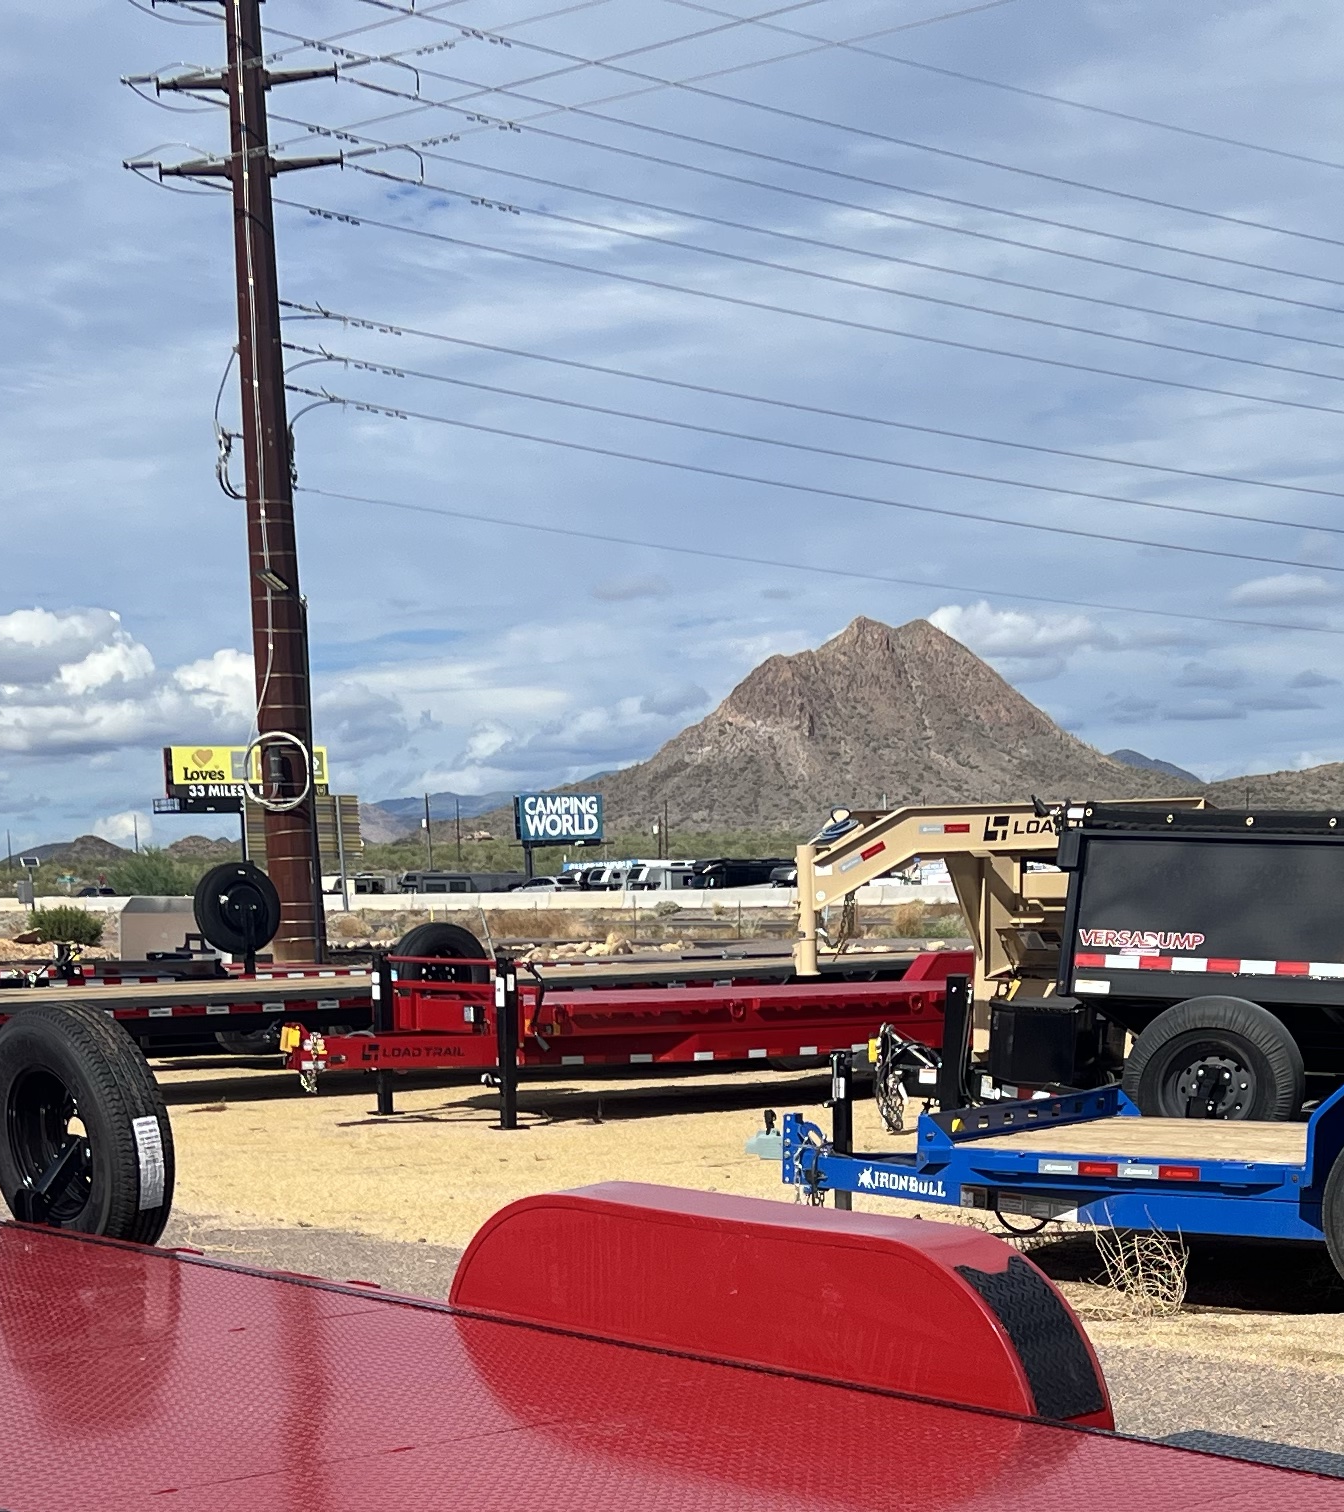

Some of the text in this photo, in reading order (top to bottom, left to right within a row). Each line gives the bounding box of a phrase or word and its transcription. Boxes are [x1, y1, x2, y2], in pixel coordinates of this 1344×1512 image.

[189, 785, 206, 797] 33
[208, 785, 244, 797] MILES
[524, 796, 598, 815] CAMPING
[525, 814, 599, 836] WORLD
[1013, 819, 1054, 835] LOA
[382, 1046, 465, 1058] LOAD TRAIL
[874, 1171, 946, 1197] IRONBULL
